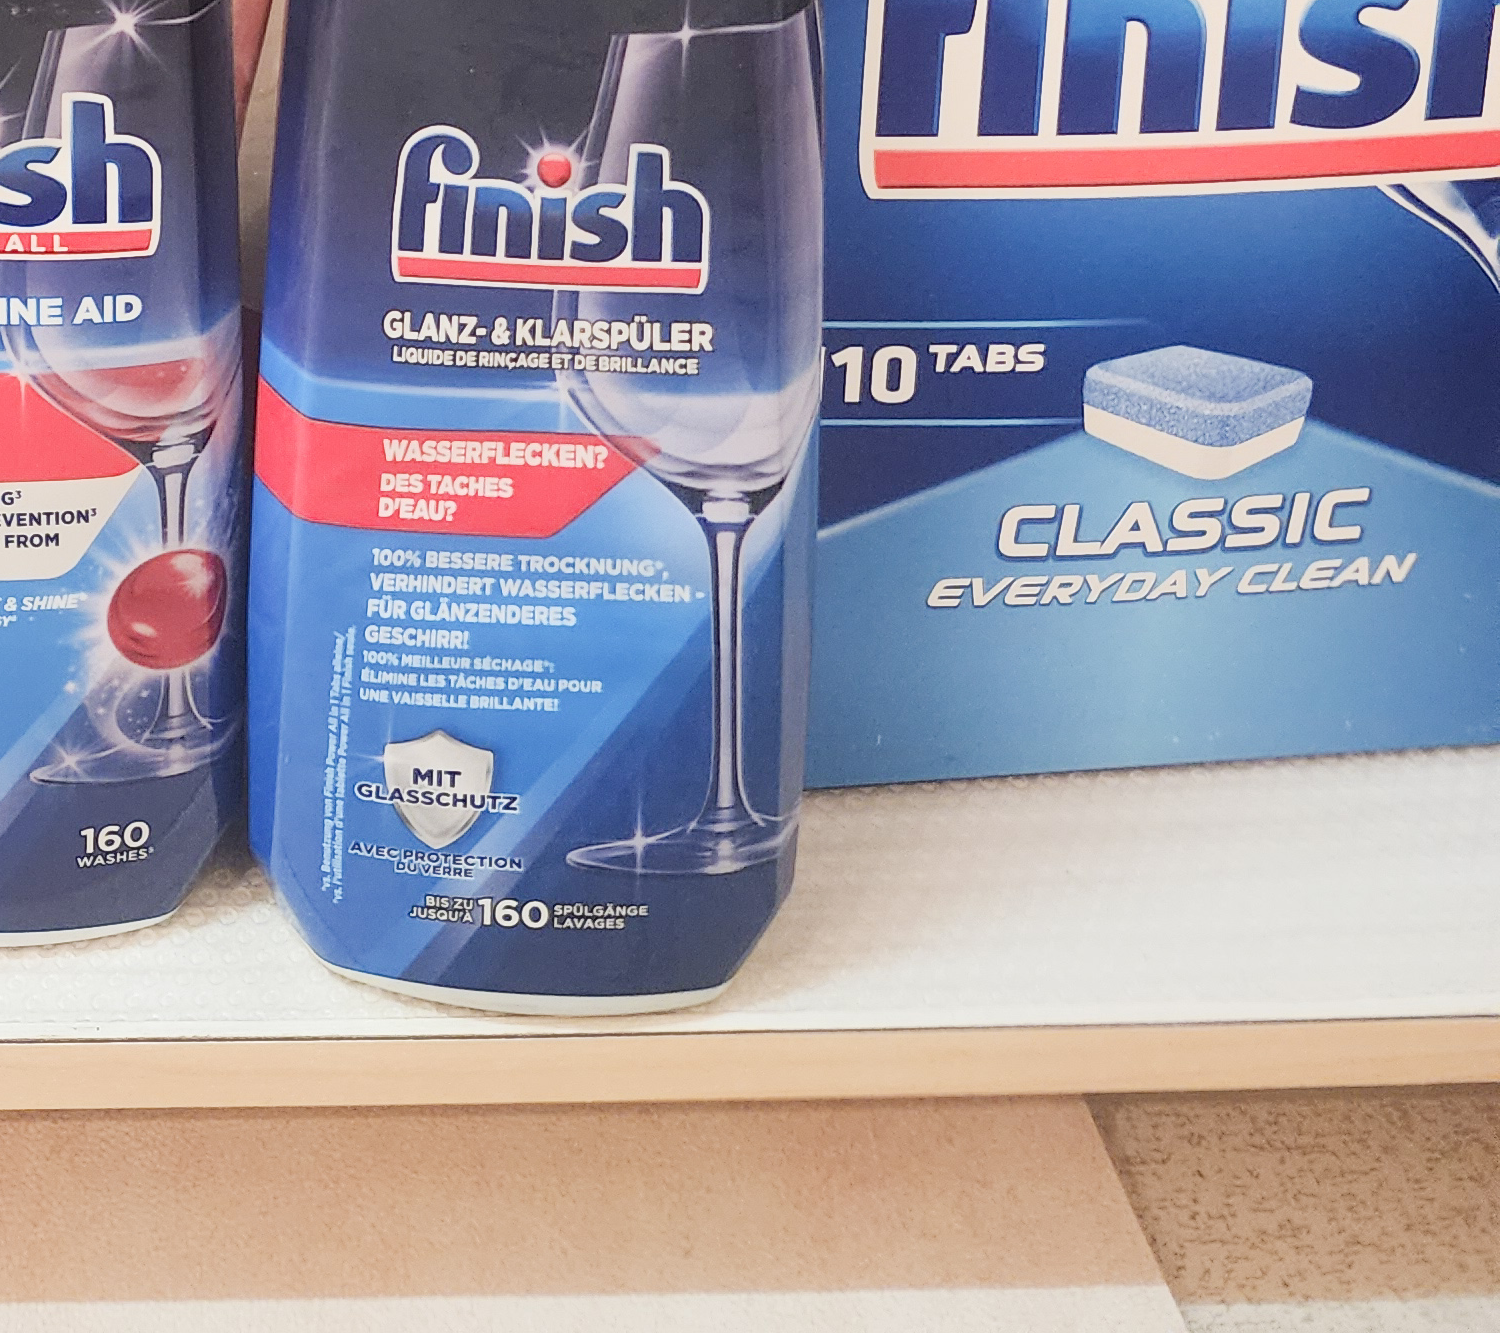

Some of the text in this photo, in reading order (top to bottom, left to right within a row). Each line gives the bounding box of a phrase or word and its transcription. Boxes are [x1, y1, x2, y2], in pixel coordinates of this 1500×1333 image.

[393, 125, 711, 266] finish
[71, 294, 144, 325] AID
[383, 310, 715, 353] GLANZ- & KLARSPÜLER
[391, 345, 700, 376] LIQUIDE DE RINÇAGE ET DE BRILLANCE
[820, 343, 1046, 405] 10 TABS
[383, 438, 610, 470] WASSERFLECKEN?
[380, 473, 514, 499] DES TACHES
[378, 496, 458, 522] D'EAU?
[997, 487, 1371, 560] CLASSIC
[4, 532, 61, 549] FROM
[371, 547, 422, 569] 100%
[425, 551, 515, 573] BESSERE
[369, 572, 497, 596] VERHINDERT
[498, 578, 692, 604] WASSERFLECKEN
[925, 553, 1418, 609] EVERYDAY CLEAN
[4, 595, 17, 612] &
[366, 596, 578, 627] FÜR GLÄNZENDERES
[364, 624, 471, 651] GESCHIRR!
[362, 649, 471, 671] 100% MEILLEUR
[360, 668, 419, 687] ÉLIMINE
[419, 674, 447, 689] LES
[507, 675, 556, 693] D'EAU
[558, 679, 604, 694] POUR
[359, 686, 561, 713] UNE VAISSELLE BRILLANTE!
[412, 767, 463, 789] MIT
[354, 781, 519, 814] GLASSCHUTZ
[80, 820, 151, 854] 160
[348, 839, 524, 871] AVEC PROTECTION
[395, 861, 475, 880] DU VERRE
[425, 894, 650, 930] BIS ZU 160 SPÜLGÄNGE
[553, 916, 626, 931] LAVAGES
